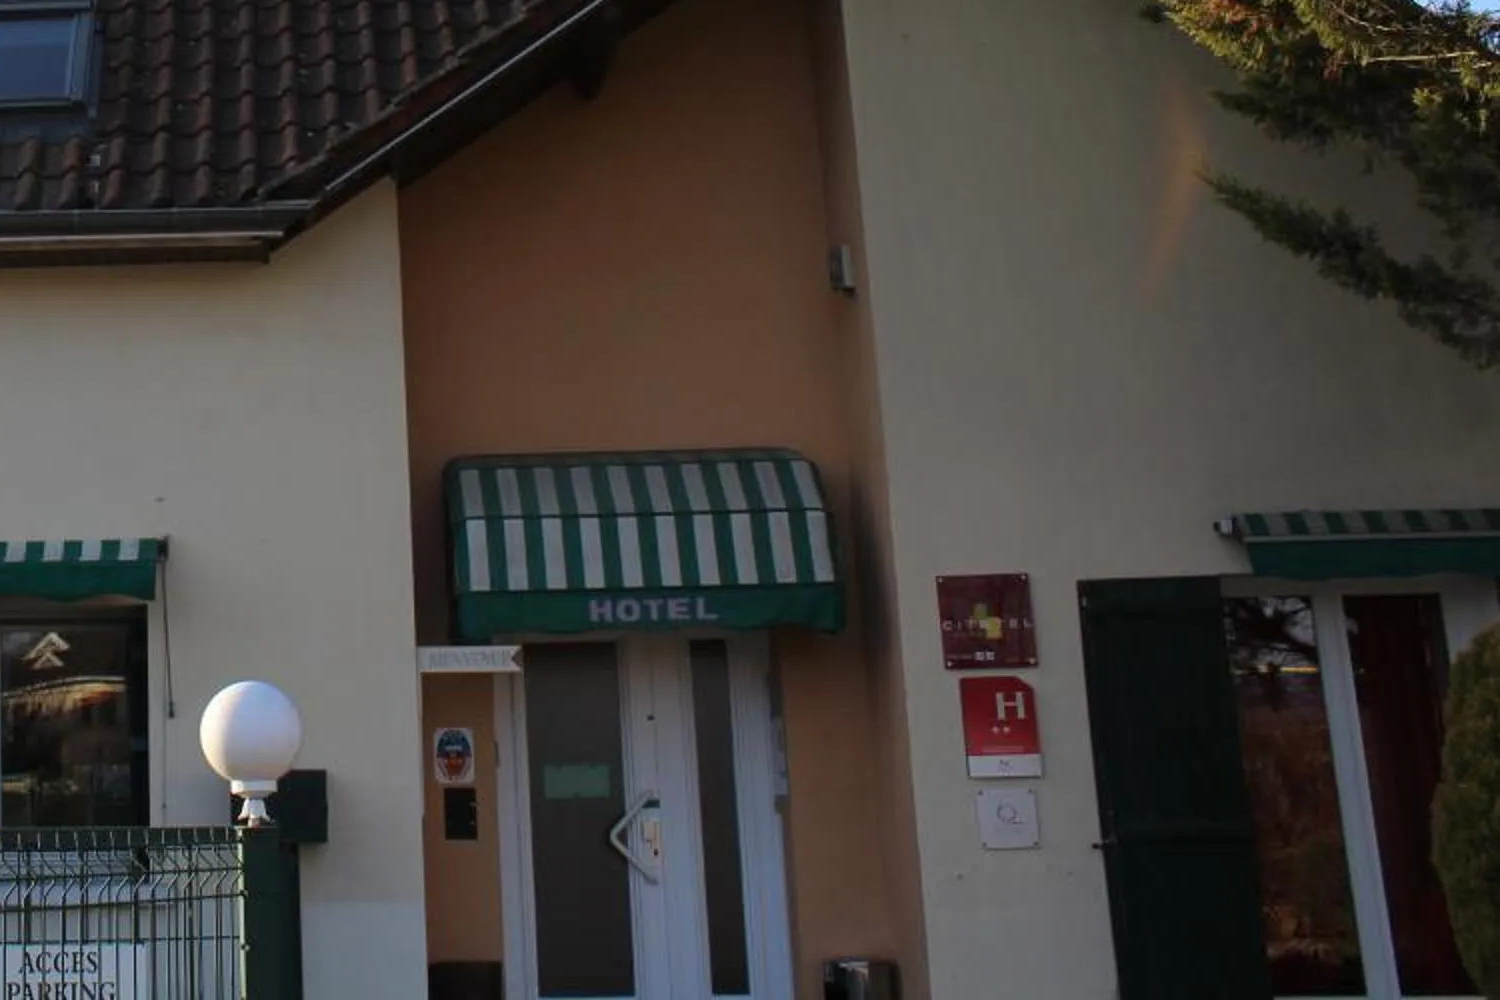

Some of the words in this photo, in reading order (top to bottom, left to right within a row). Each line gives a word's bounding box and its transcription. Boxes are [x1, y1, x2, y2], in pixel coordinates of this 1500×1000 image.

[589, 597, 720, 623] HOTEL
[995, 692, 1027, 720] H
[18, 951, 99, 974] ACCES
[7, 982, 115, 1000] PARKING
